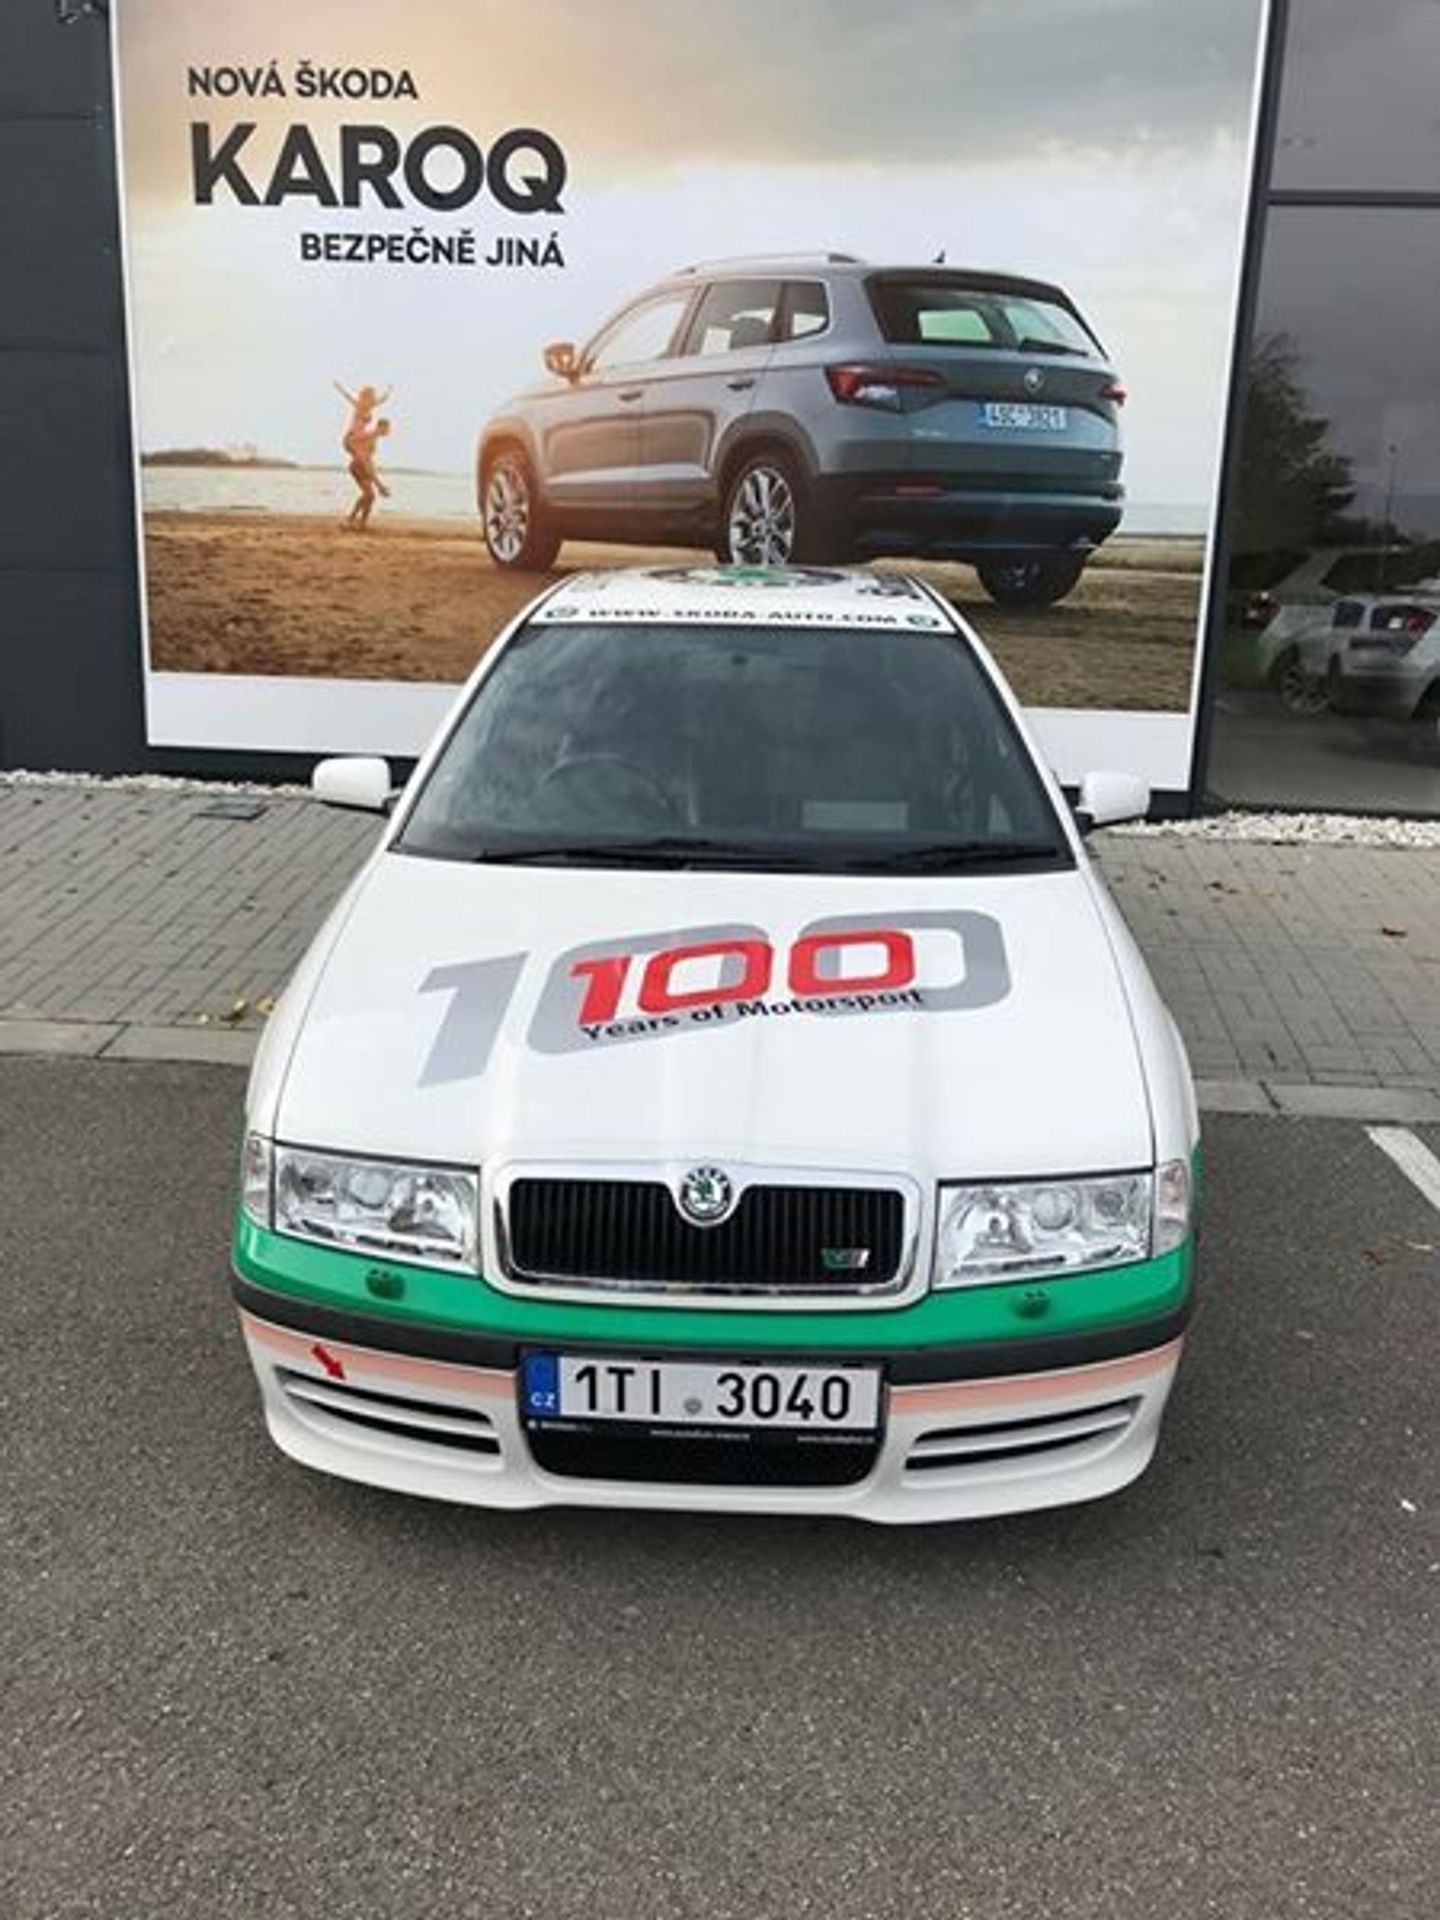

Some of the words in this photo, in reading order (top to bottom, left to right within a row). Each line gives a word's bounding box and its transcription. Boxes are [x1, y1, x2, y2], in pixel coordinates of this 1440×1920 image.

[188, 60, 286, 97] NOVÁ
[295, 60, 419, 100] ŠKODA
[190, 121, 567, 214] KAROQ
[301, 227, 475, 264] BEZPEČNĚ
[485, 231, 565, 267] JINÁ
[569, 930, 915, 1025] 100
[579, 1016, 679, 1041] Years
[690, 1003, 724, 1022] of
[735, 988, 923, 1017] Motorsport
[530, 1391, 555, 1409] CZ
[575, 1365, 661, 1415] 1TI
[716, 1372, 850, 1421] 3040
